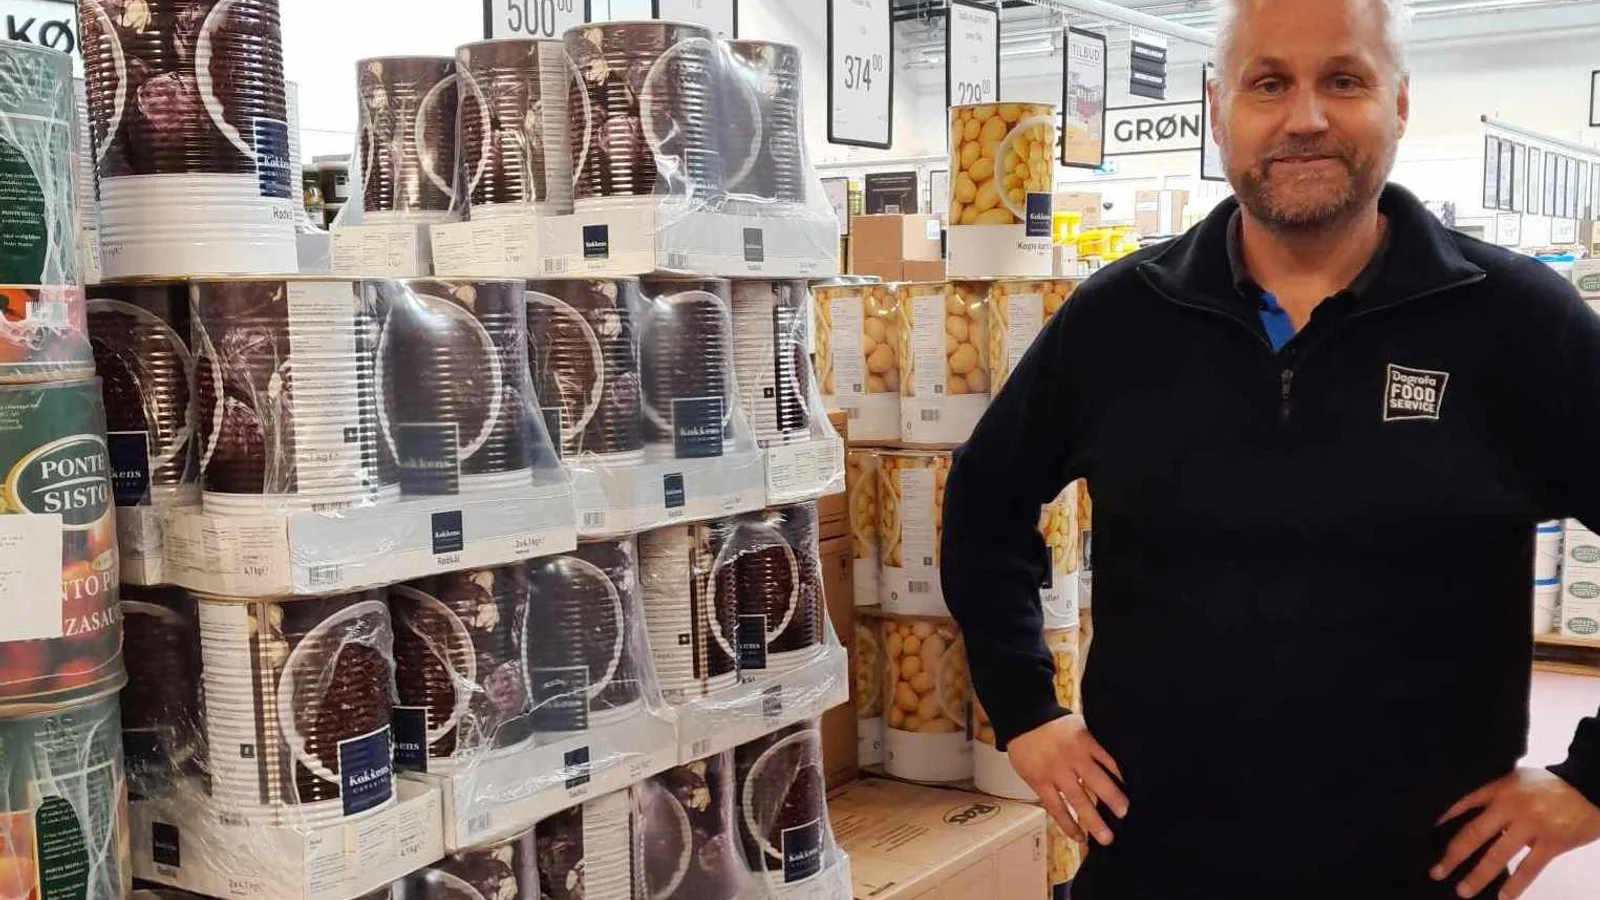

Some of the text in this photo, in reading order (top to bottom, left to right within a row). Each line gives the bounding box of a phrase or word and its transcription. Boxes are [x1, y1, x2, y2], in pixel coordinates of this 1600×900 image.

[1073, 44, 1101, 62] TILBUD
[844, 55, 872, 91] 374
[1114, 114, 1201, 142] GRØN
[1391, 370, 1437, 387] Dagrofa
[1391, 383, 1436, 402] FOOD
[1389, 398, 1436, 413] SERVICE
[41, 453, 105, 480] PONTE
[44, 483, 108, 512] SISTO
[349, 766, 389, 786] Kokkens
